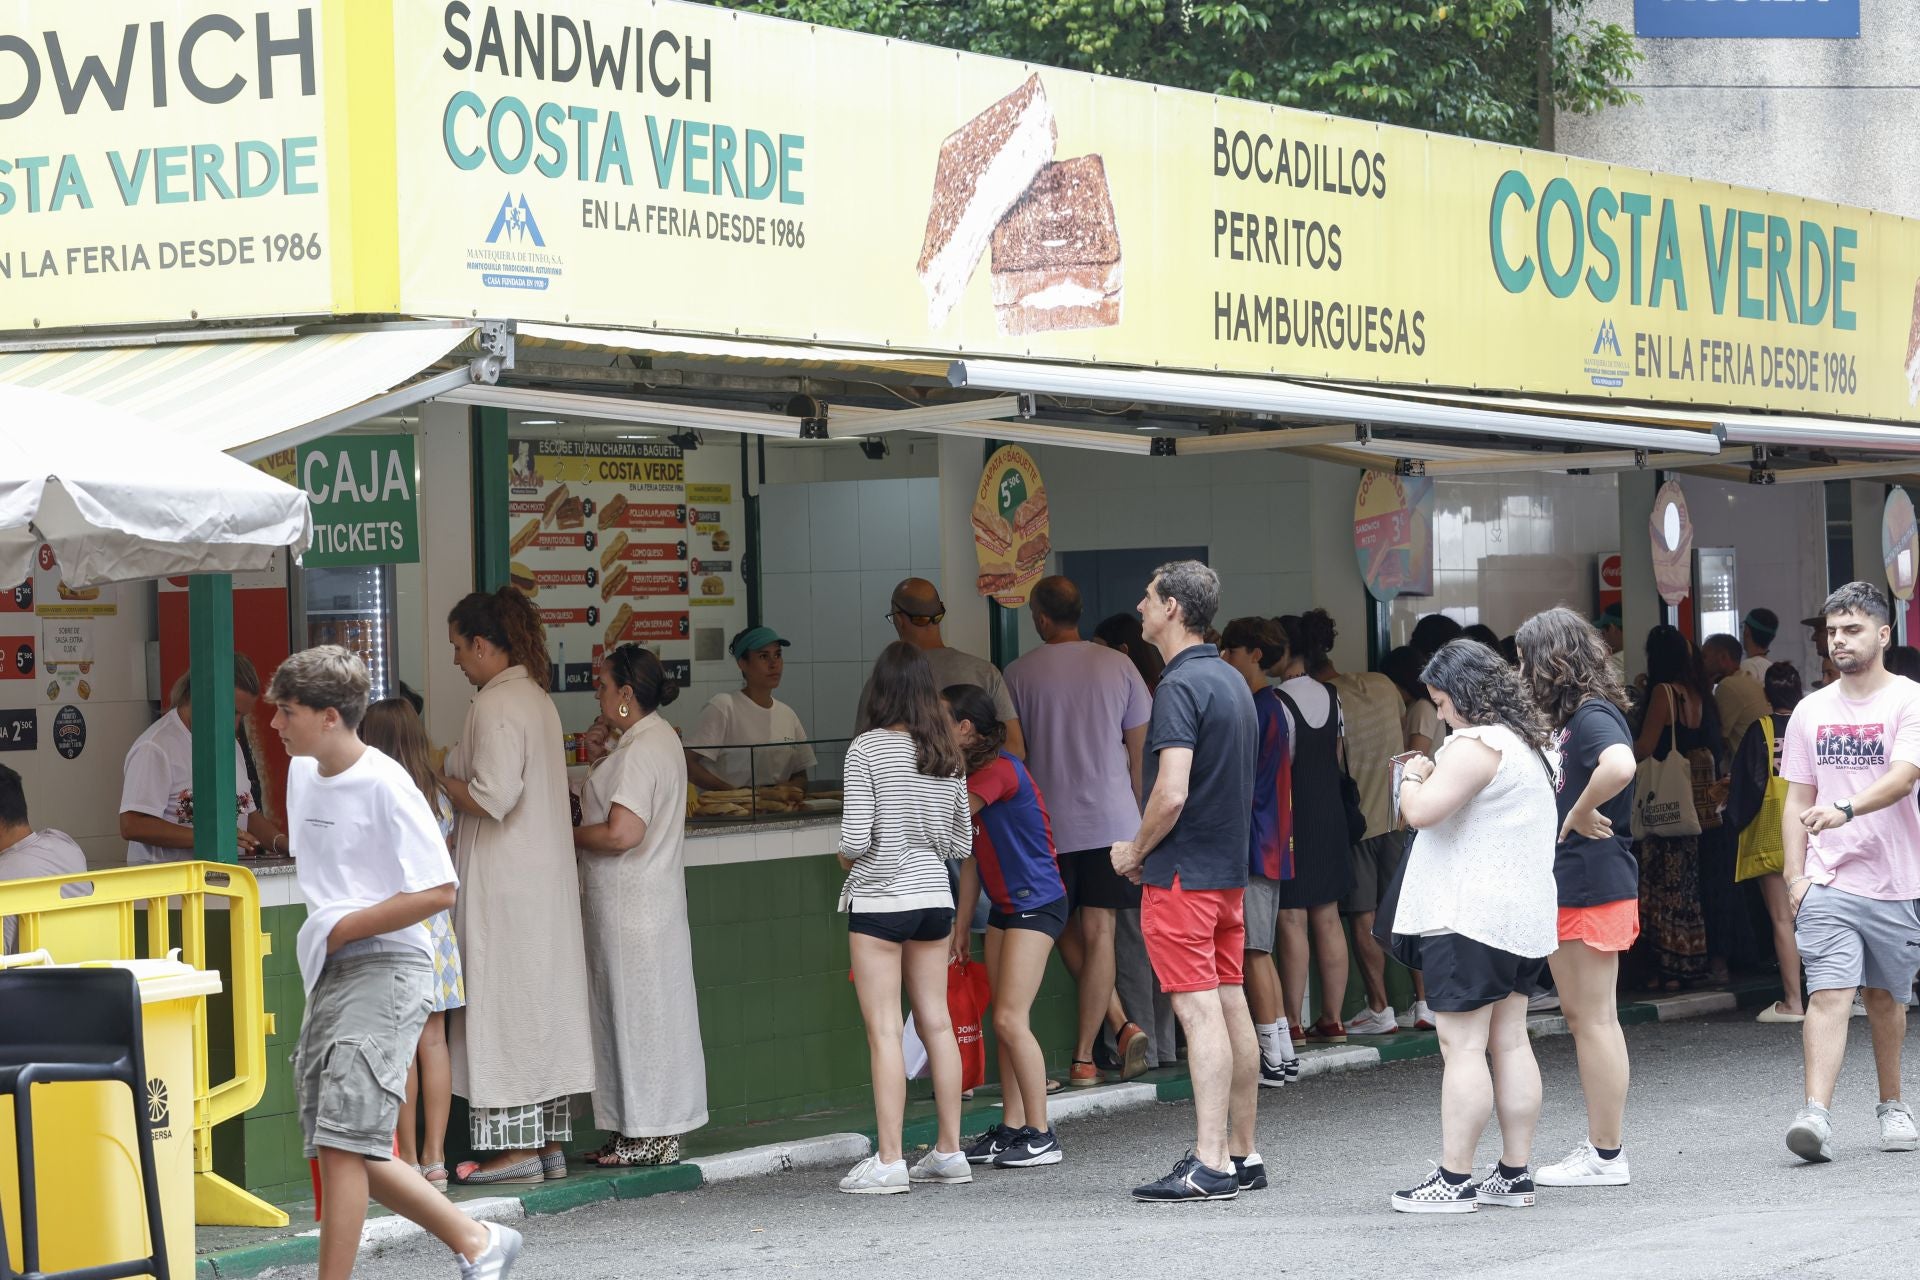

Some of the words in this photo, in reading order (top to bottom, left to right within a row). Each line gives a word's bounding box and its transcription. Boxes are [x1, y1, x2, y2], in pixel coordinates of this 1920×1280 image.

[442, 0, 712, 103] SANDWICH
[106, 136, 319, 207] VERDE
[442, 90, 634, 186] COSTA
[645, 115, 805, 205] VERDE
[1214, 126, 1387, 200] BOCADILLOS
[582, 198, 608, 229] EN
[615, 201, 641, 234] LA
[646, 205, 702, 239] FERIA
[707, 211, 766, 246] DESDE
[770, 218, 806, 249] 1986
[1214, 208, 1342, 272] PERRITOS
[1490, 169, 1688, 311] COSTA
[1699, 203, 1858, 331] VERDE
[21, 250, 59, 278] LA
[67, 243, 150, 275] FERIA
[159, 236, 254, 270] DESDE
[263, 232, 322, 263] 1986
[1214, 291, 1426, 357] HAMBURGUESAS
[1635, 332, 1662, 379] EN
[1669, 336, 1697, 382] LA
[1700, 339, 1755, 389] FERIA
[1759, 346, 1820, 392] DESDE
[1823, 354, 1857, 396] 1986
[304, 449, 411, 505] CAJA
[585, 443, 600, 455] PAN
[602, 443, 637, 456] CHAPATA
[643, 444, 681, 457] BAGUETTE
[600, 461, 642, 480] COSTA
[644, 463, 684, 481] VERDE
[980, 456, 1004, 500] CHAPATA
[1006, 450, 1038, 484] BAGUETTE
[314, 521, 404, 554] TICKETS
[567, 673, 581, 684] AGUA
